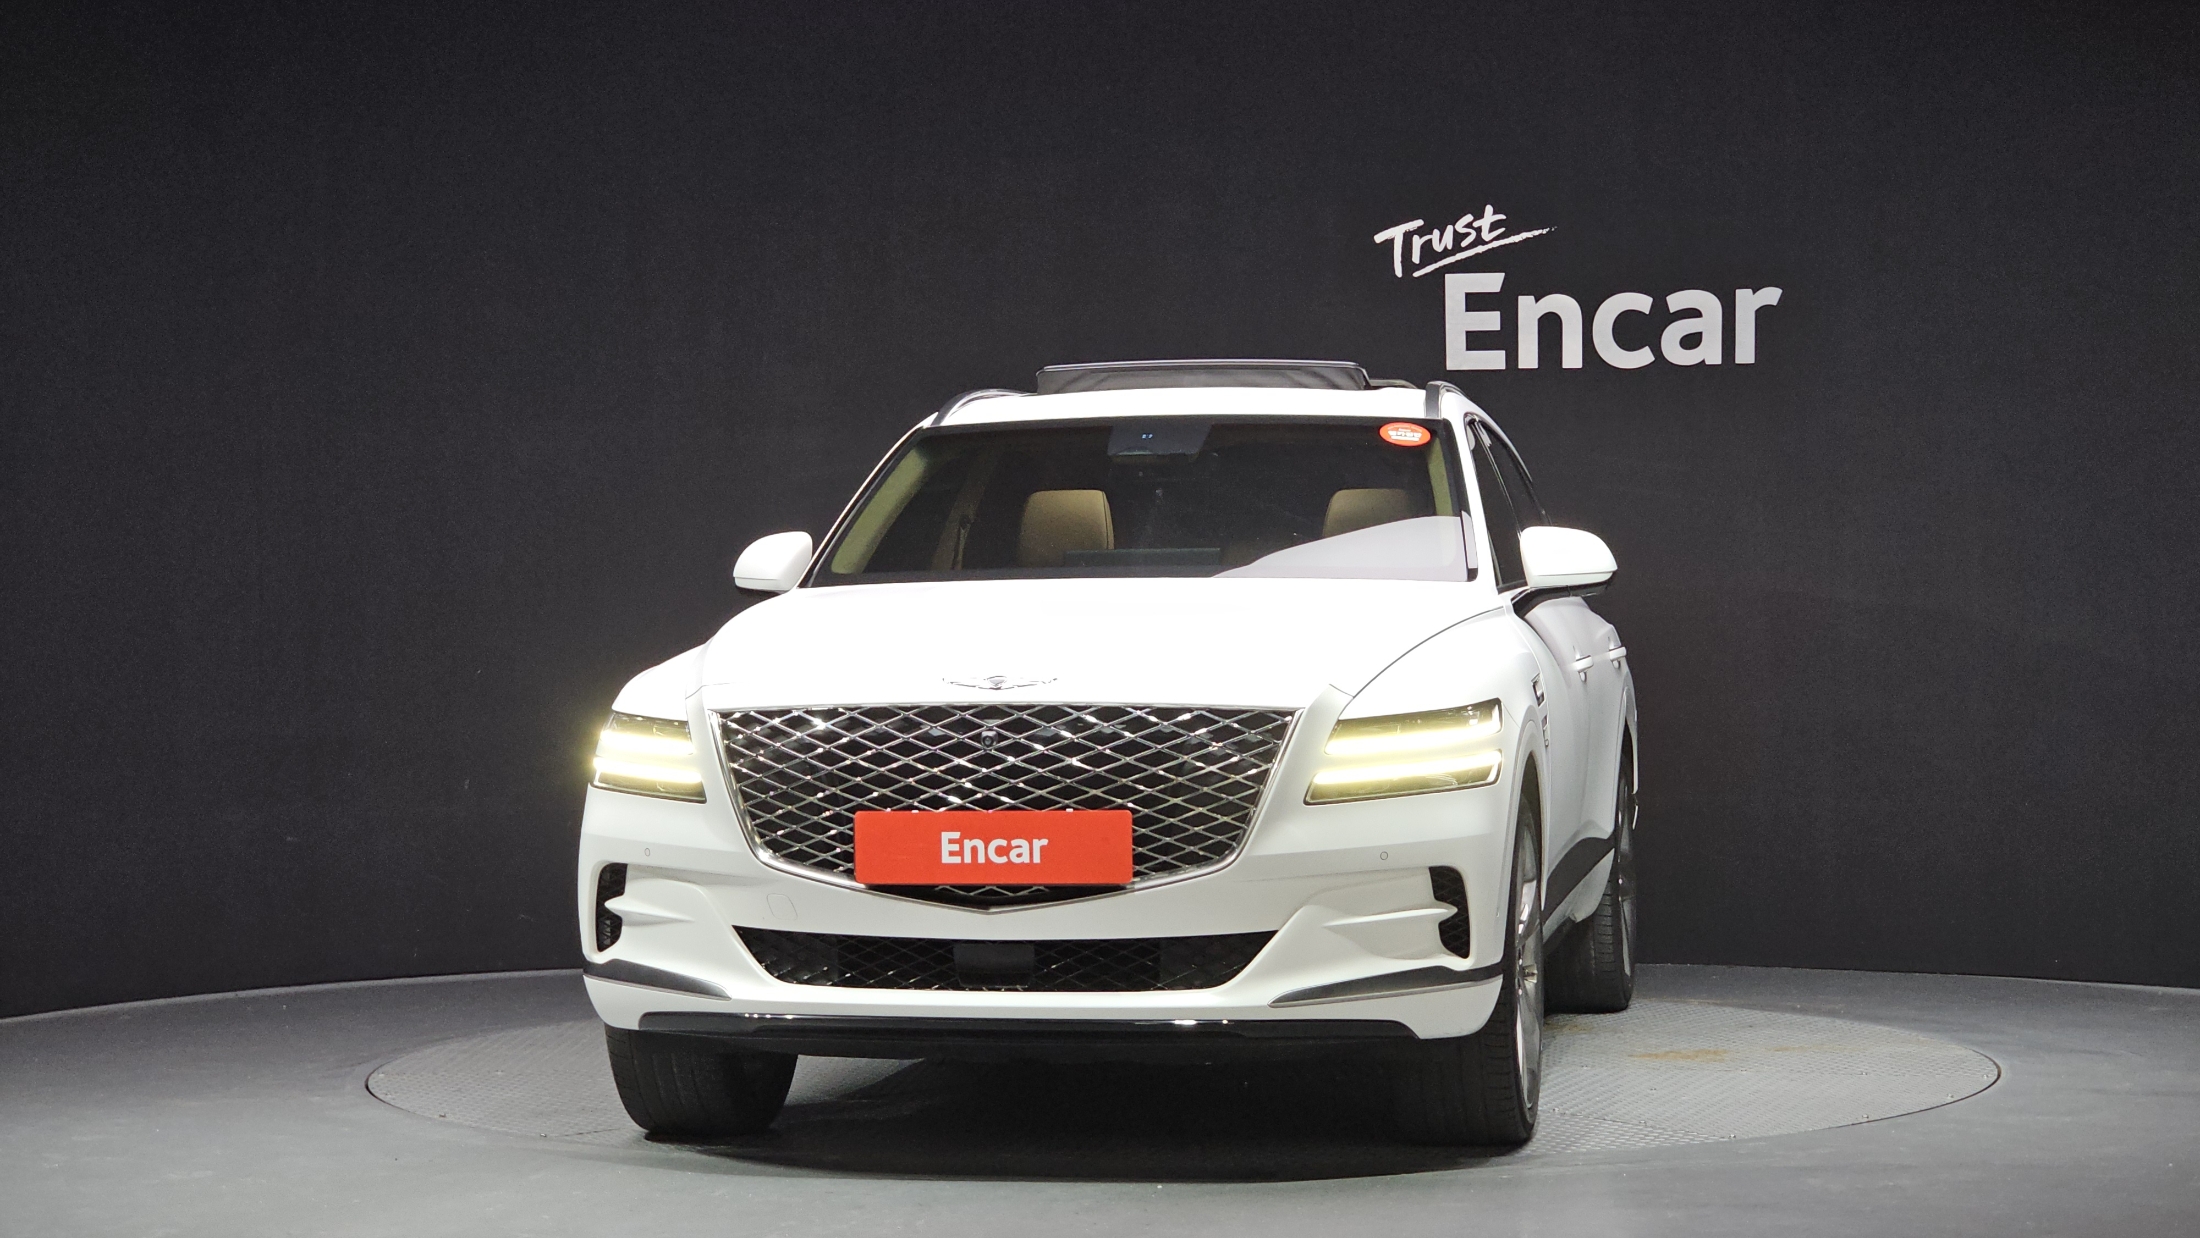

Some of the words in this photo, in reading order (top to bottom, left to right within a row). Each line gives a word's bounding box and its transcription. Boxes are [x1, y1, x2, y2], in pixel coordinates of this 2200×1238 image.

[1374, 205, 1507, 278] Trust
[1445, 273, 1783, 371] Encar
[941, 831, 1049, 864] Encar
